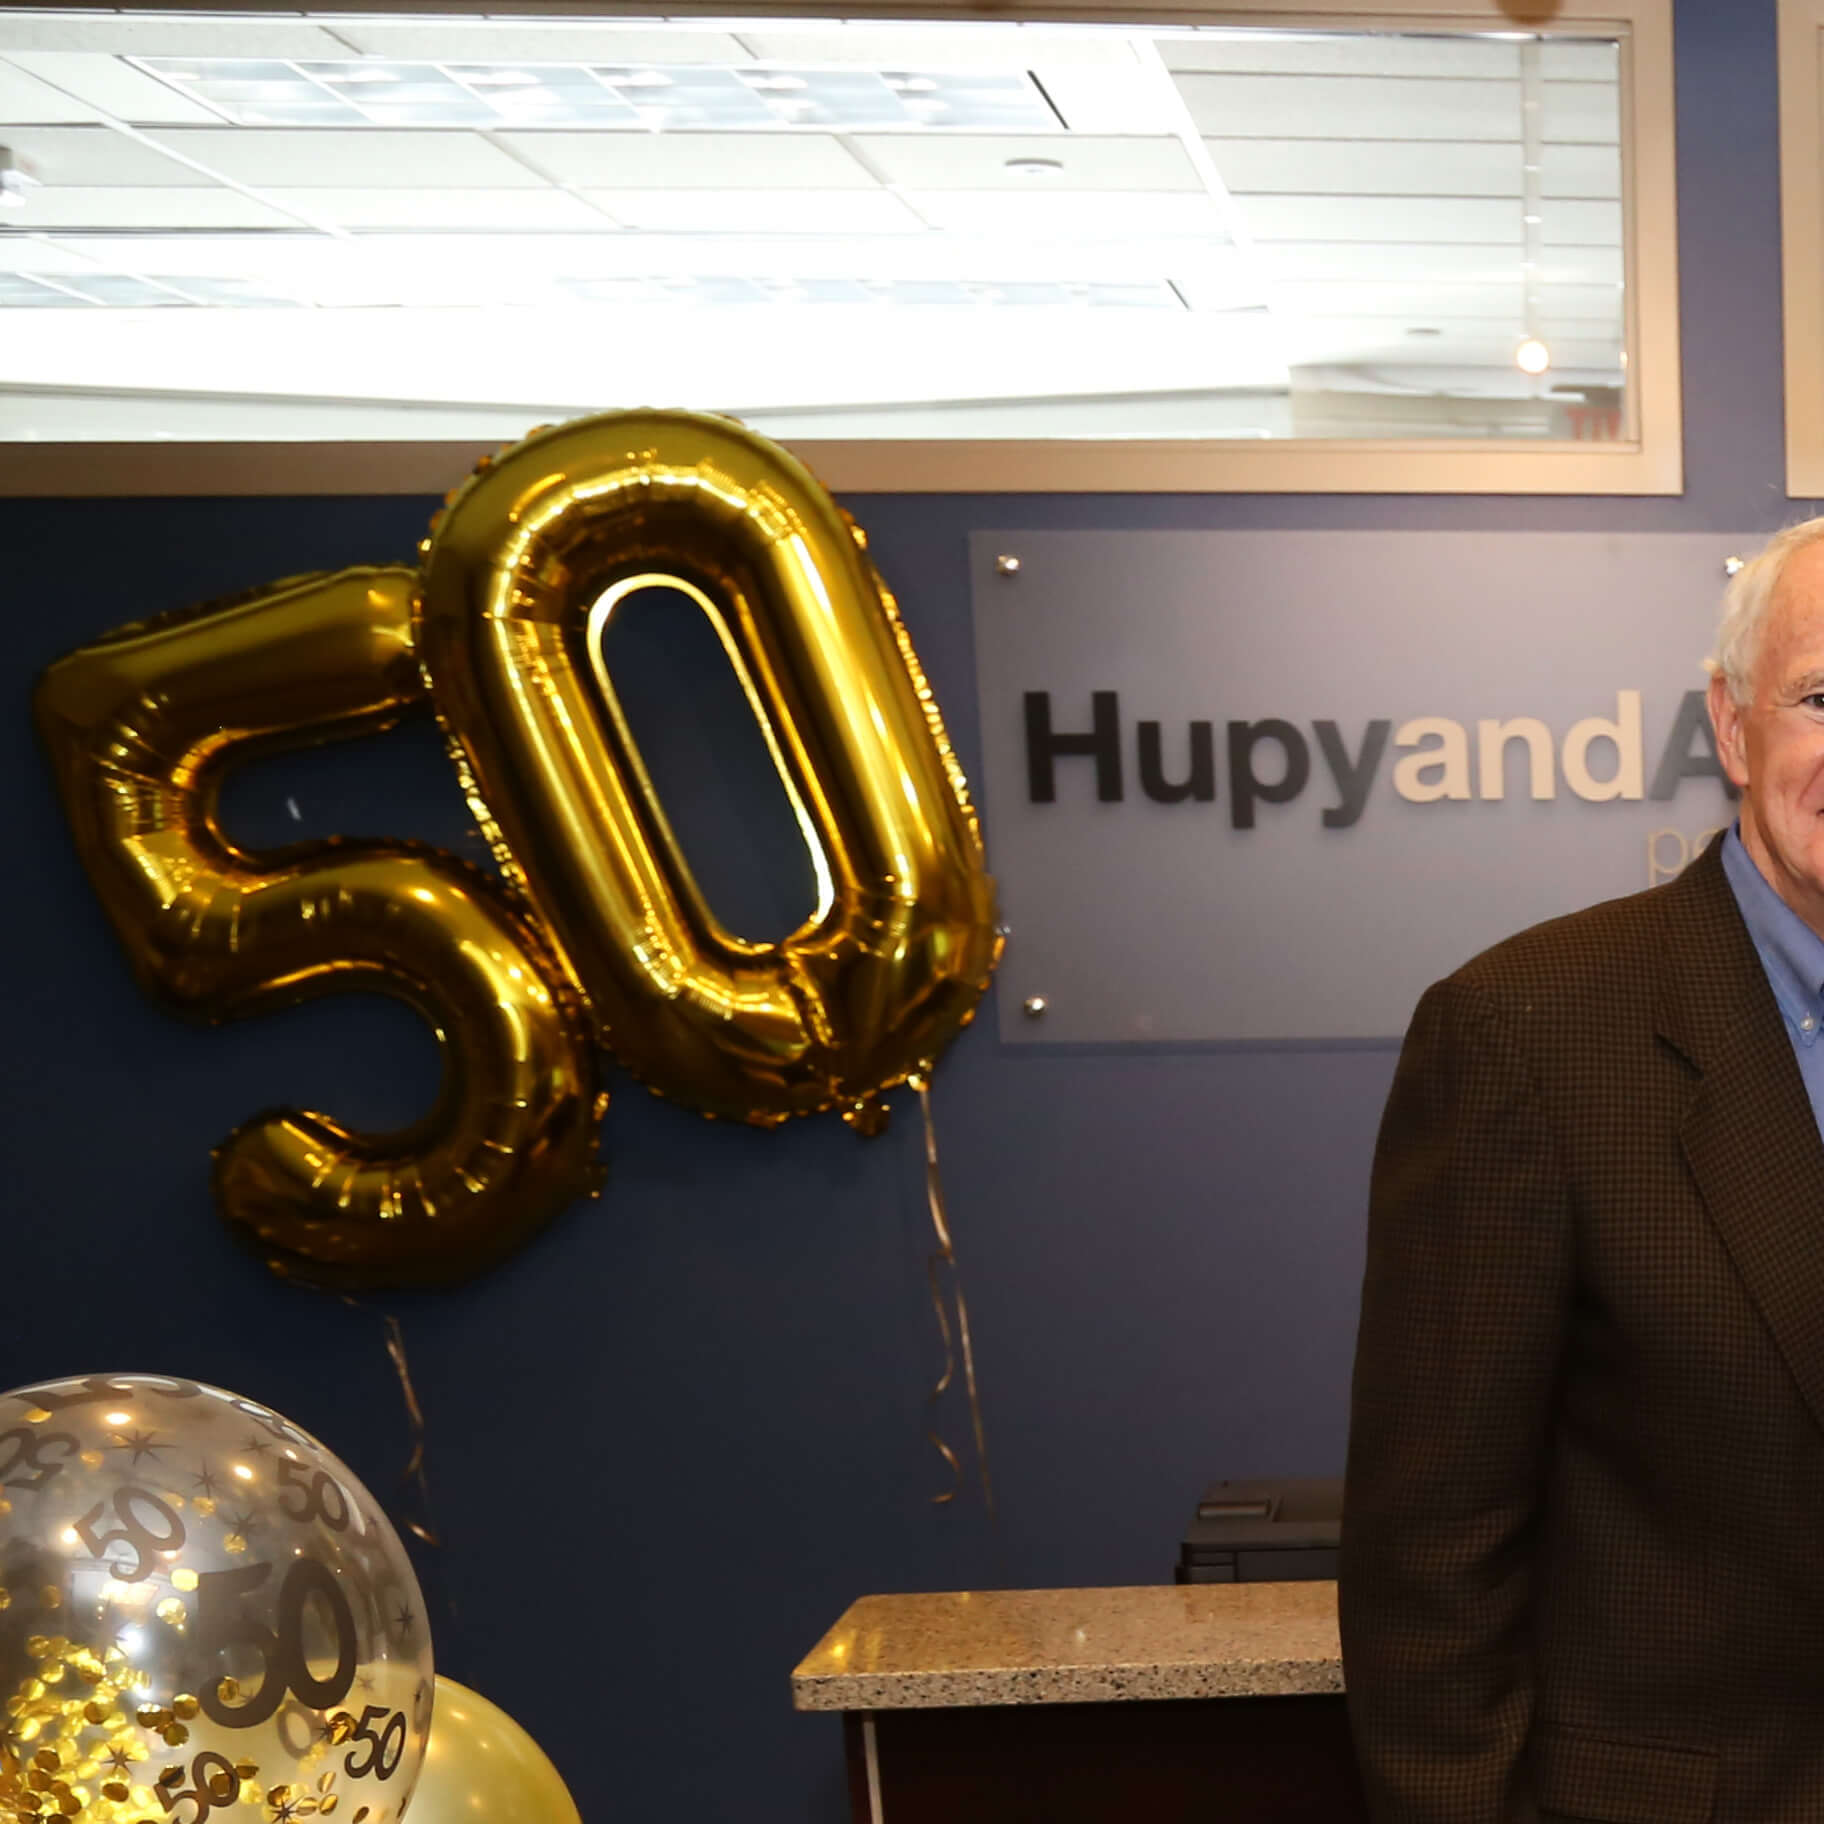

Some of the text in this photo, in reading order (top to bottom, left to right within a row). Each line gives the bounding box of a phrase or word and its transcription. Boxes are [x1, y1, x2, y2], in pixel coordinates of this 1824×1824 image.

[33, 408, 998, 1290] 50
[73, 1486, 186, 1583] 50
[344, 1705, 407, 1781] 50
